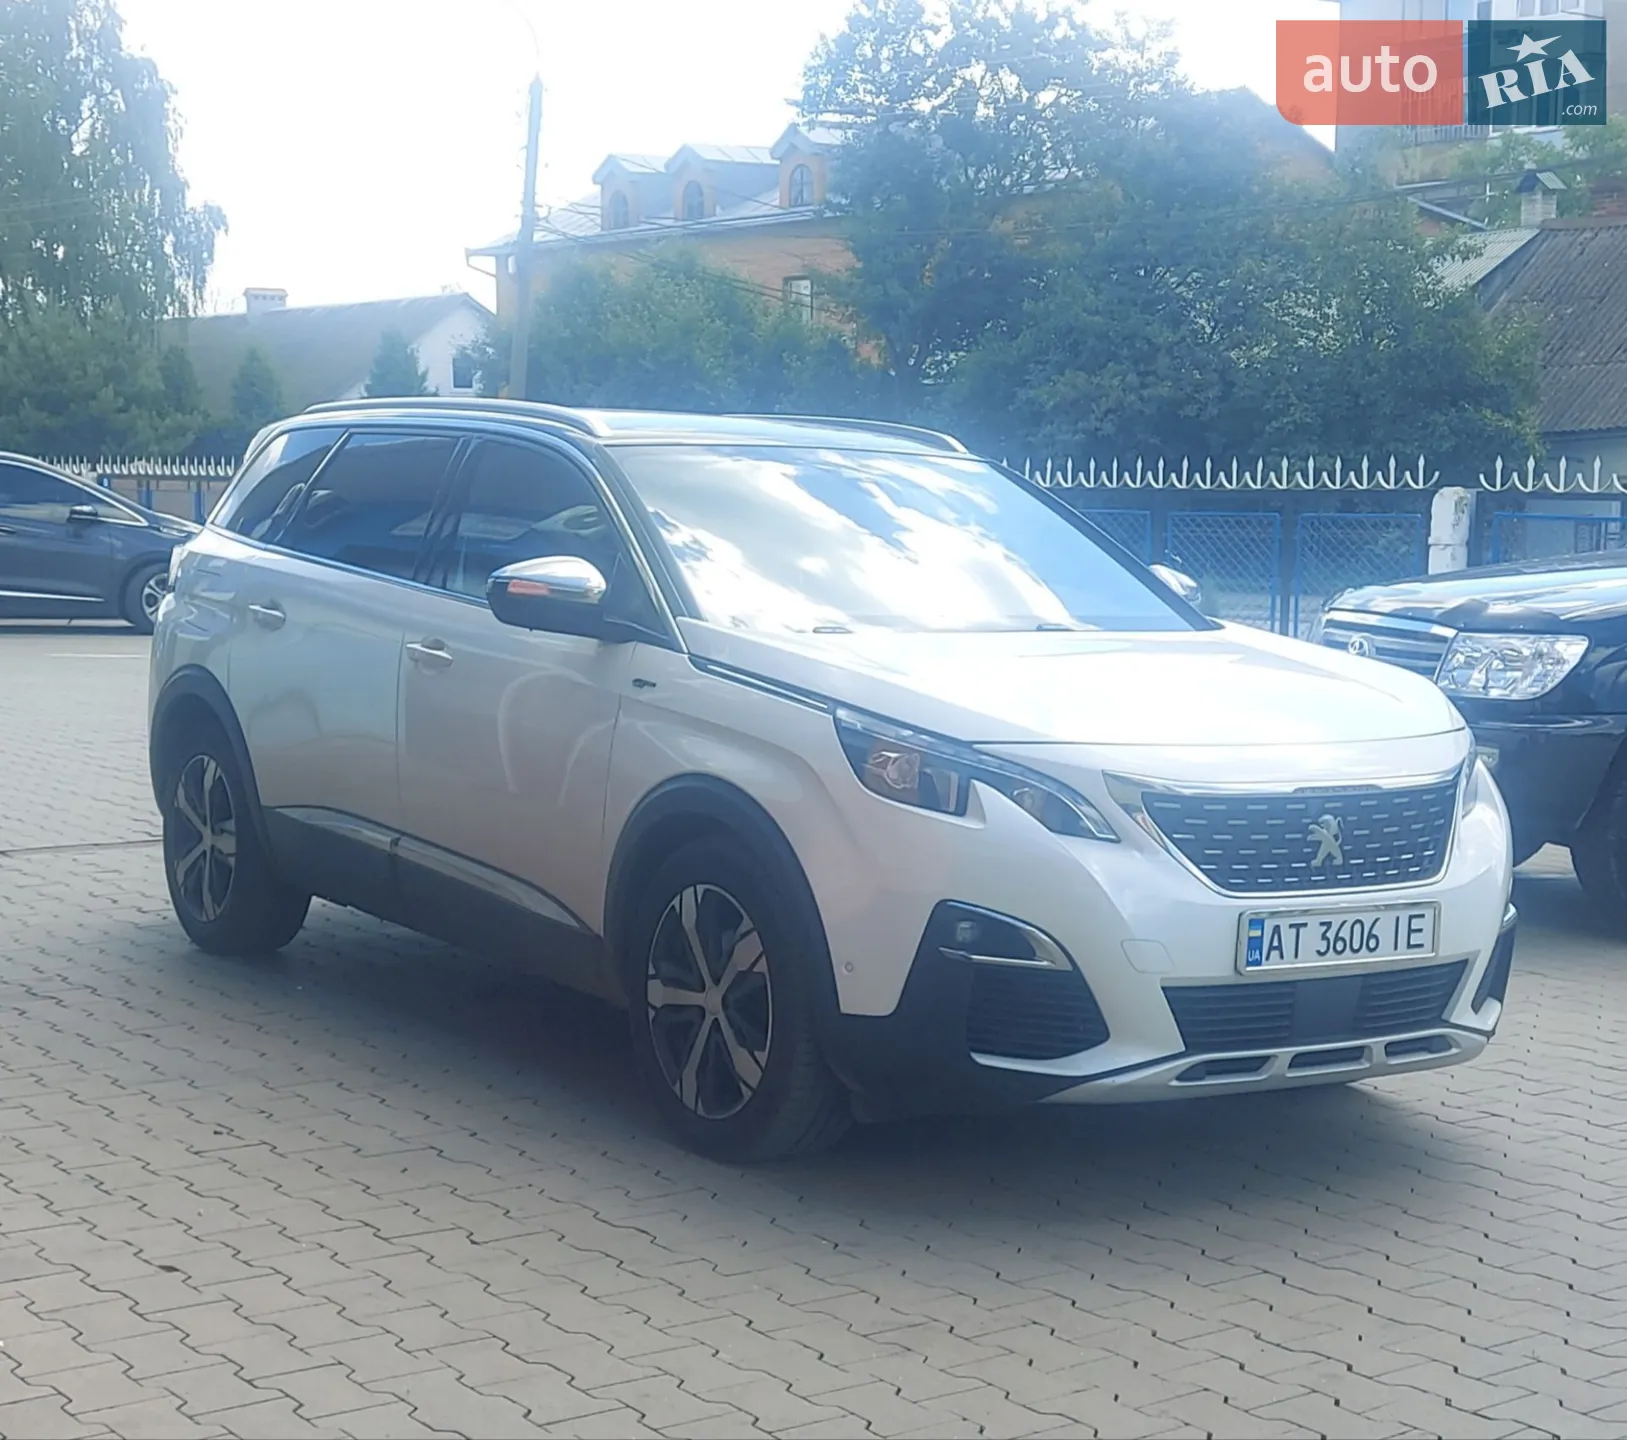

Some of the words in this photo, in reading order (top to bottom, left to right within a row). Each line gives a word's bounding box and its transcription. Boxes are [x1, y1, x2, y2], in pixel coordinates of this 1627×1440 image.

[1265, 922, 1308, 961] AT
[1315, 917, 1381, 956] 3606
[1394, 914, 1425, 951] IE
[1248, 951, 1260, 961] UA
